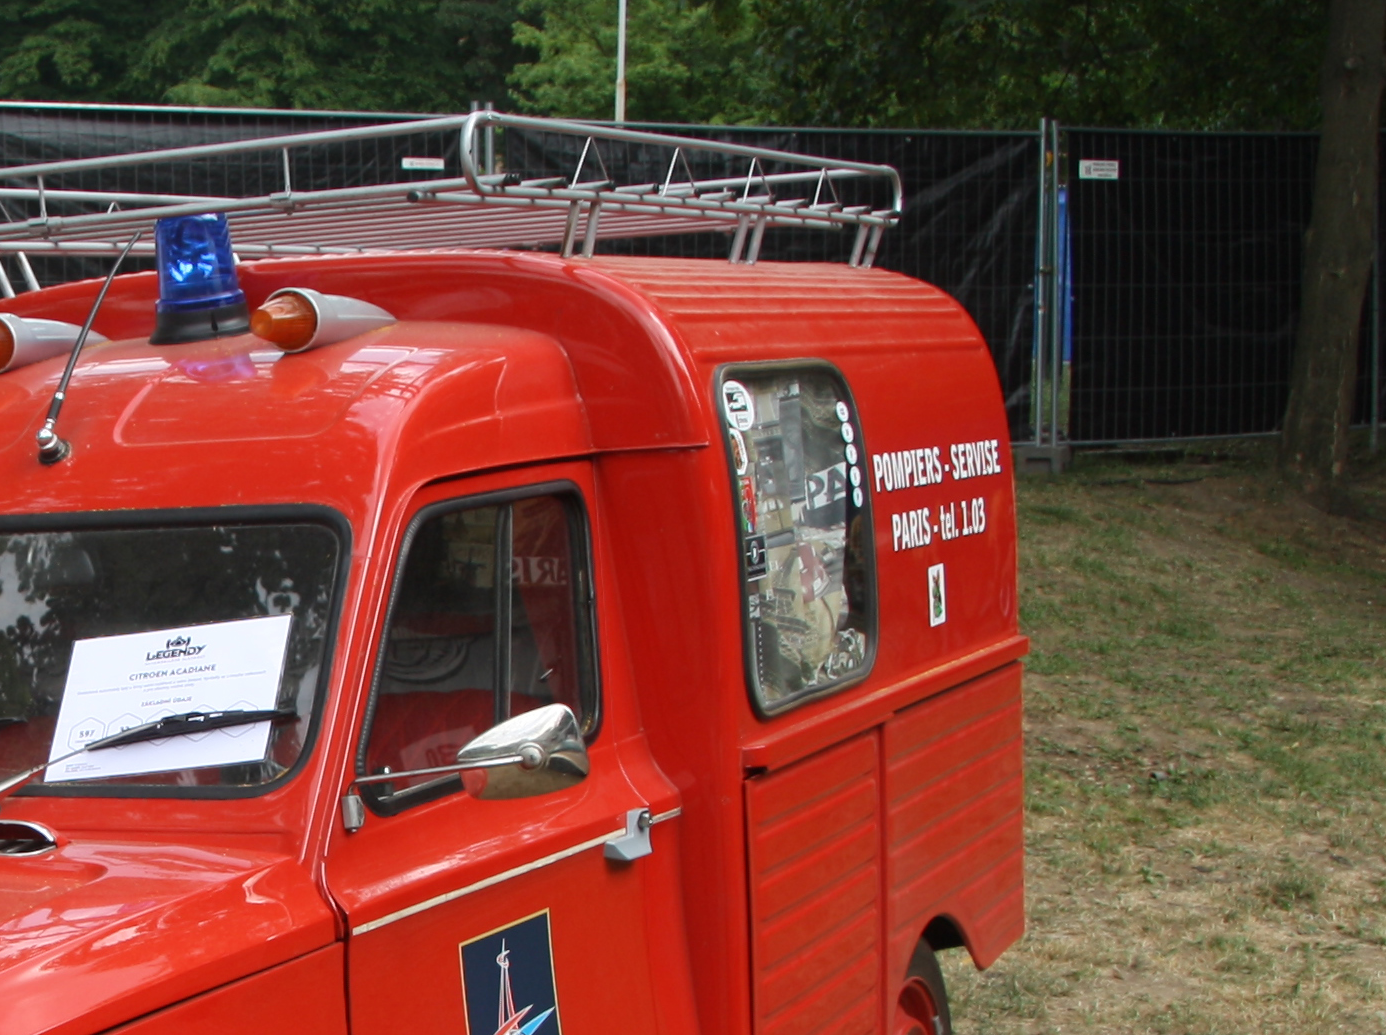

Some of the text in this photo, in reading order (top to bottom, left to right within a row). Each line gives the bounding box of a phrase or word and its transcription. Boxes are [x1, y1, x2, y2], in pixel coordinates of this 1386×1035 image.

[873, 446, 942, 492] POMPIERS
[950, 439, 1001, 480] SERVISE
[892, 507, 931, 552] PARIS
[940, 502, 959, 541] tel.
[961, 497, 986, 536] 1.03
[145, 645, 207, 662] LEGENDY
